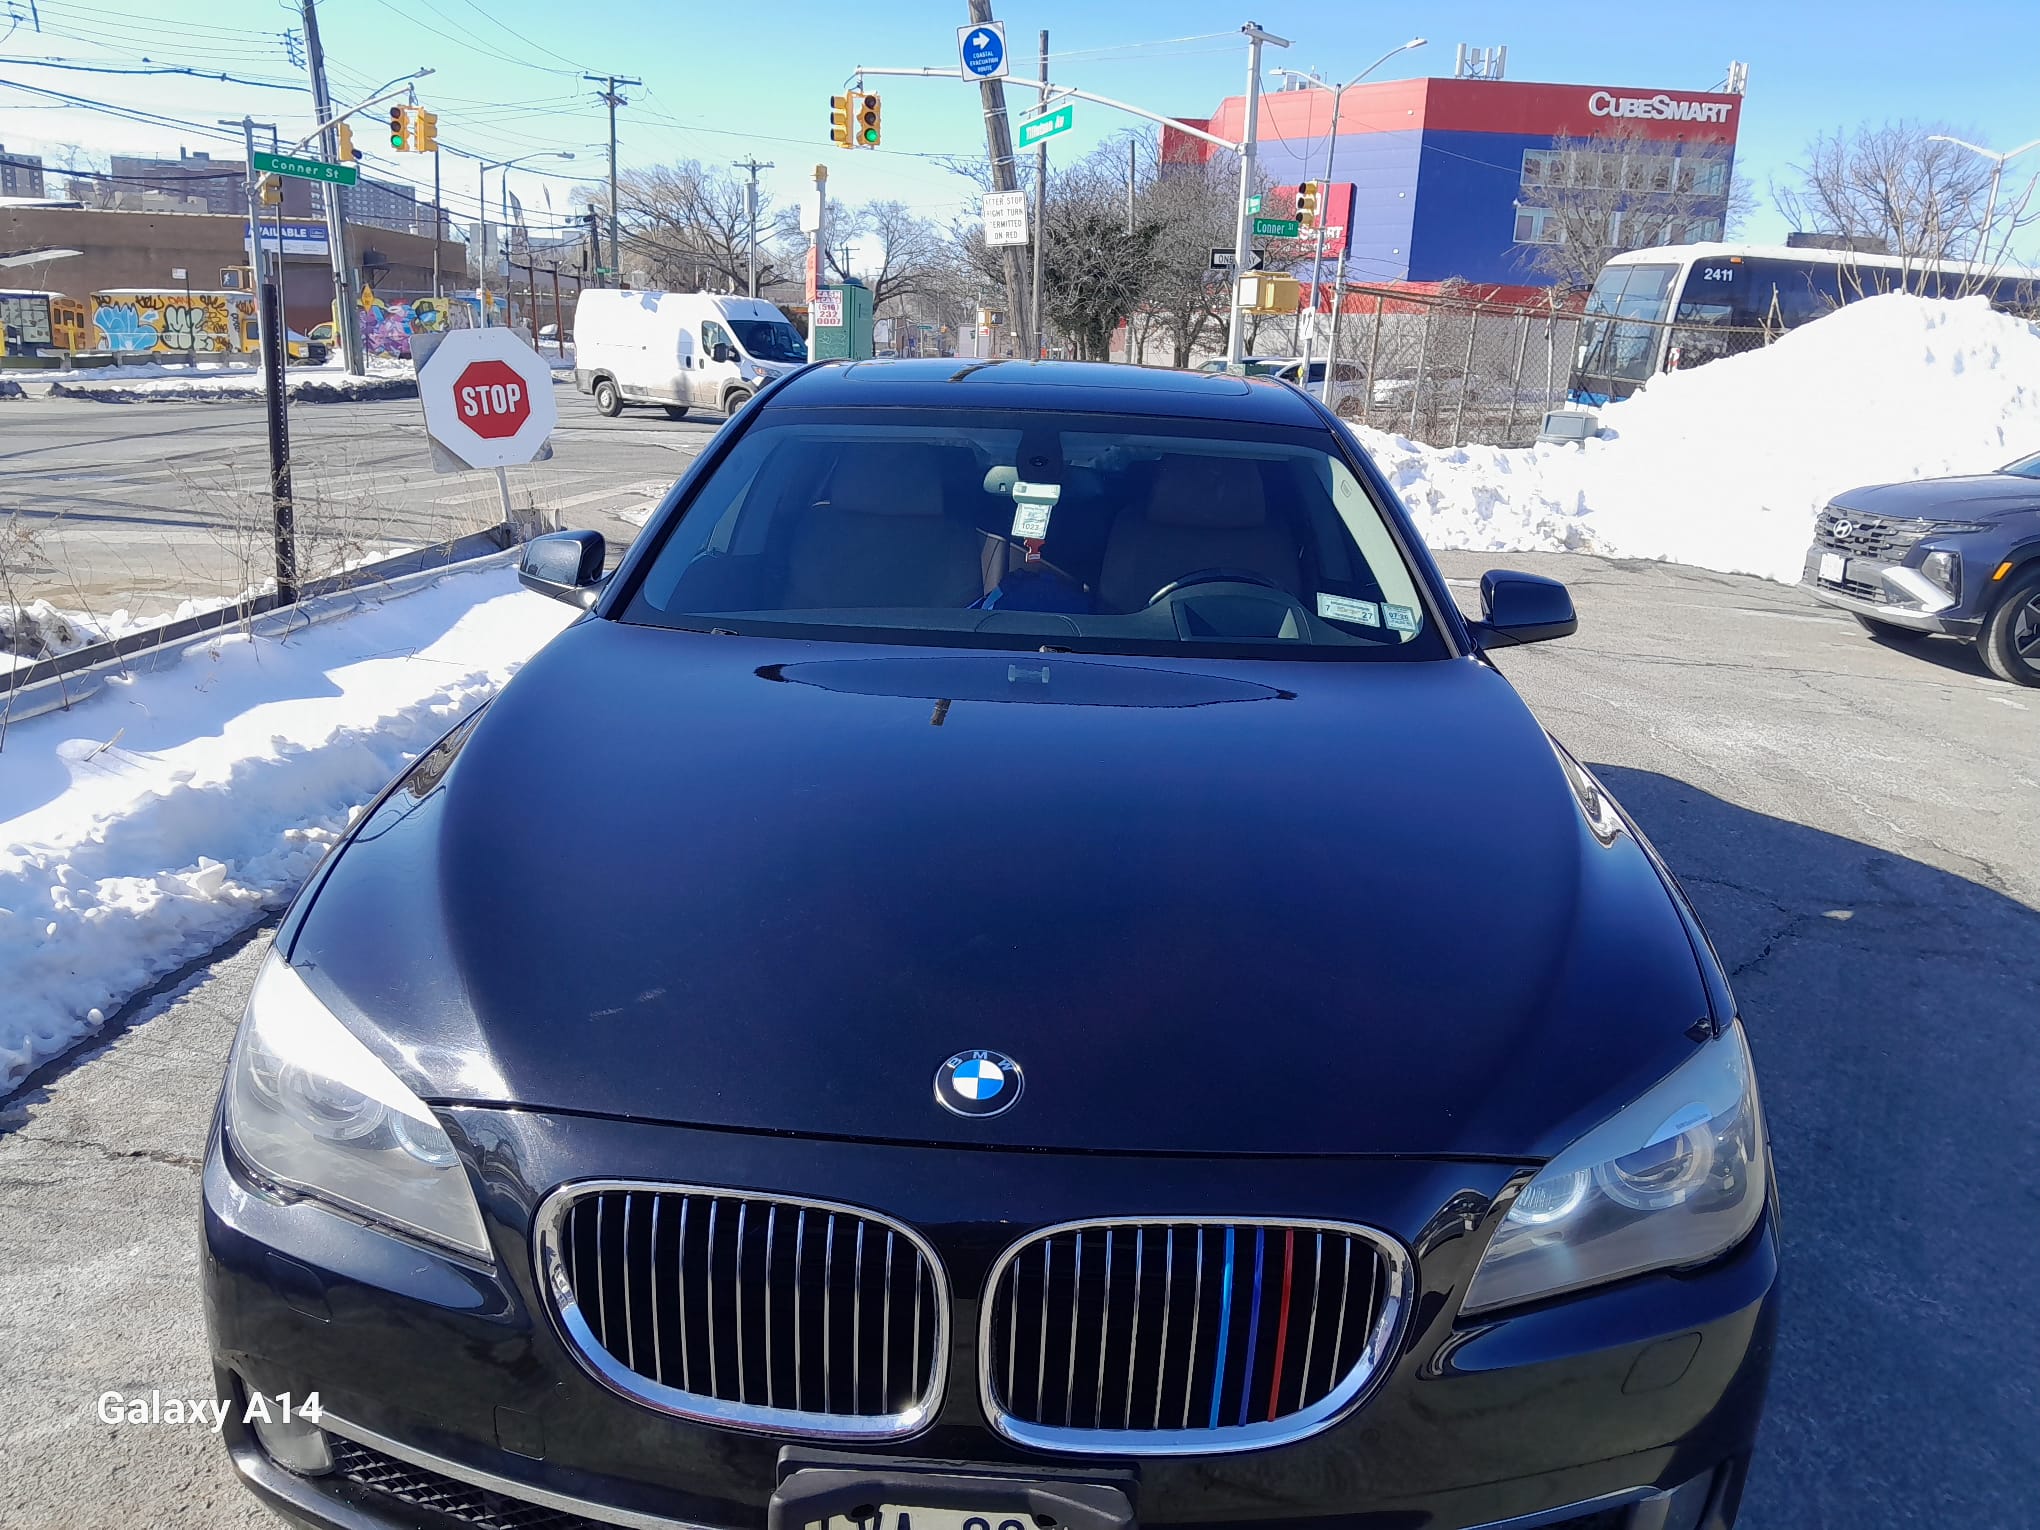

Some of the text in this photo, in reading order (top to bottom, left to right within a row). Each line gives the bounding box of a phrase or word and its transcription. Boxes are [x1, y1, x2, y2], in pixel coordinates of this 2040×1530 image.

[271, 159, 339, 179] Conner St
[1007, 196, 1023, 205] STOP
[1007, 208, 1024, 217] TURN
[990, 219, 1022, 229] ERMITTED
[1256, 220, 1286, 235] Conner
[247, 225, 307, 238] AILABLE
[994, 231, 1018, 240] ON RED
[1218, 254, 1234, 264] ONE
[1703, 267, 1733, 282] 2411
[461, 383, 521, 417] STOP
[1361, 611, 1373, 620] 27
[946, 1051, 1014, 1072] BMW
